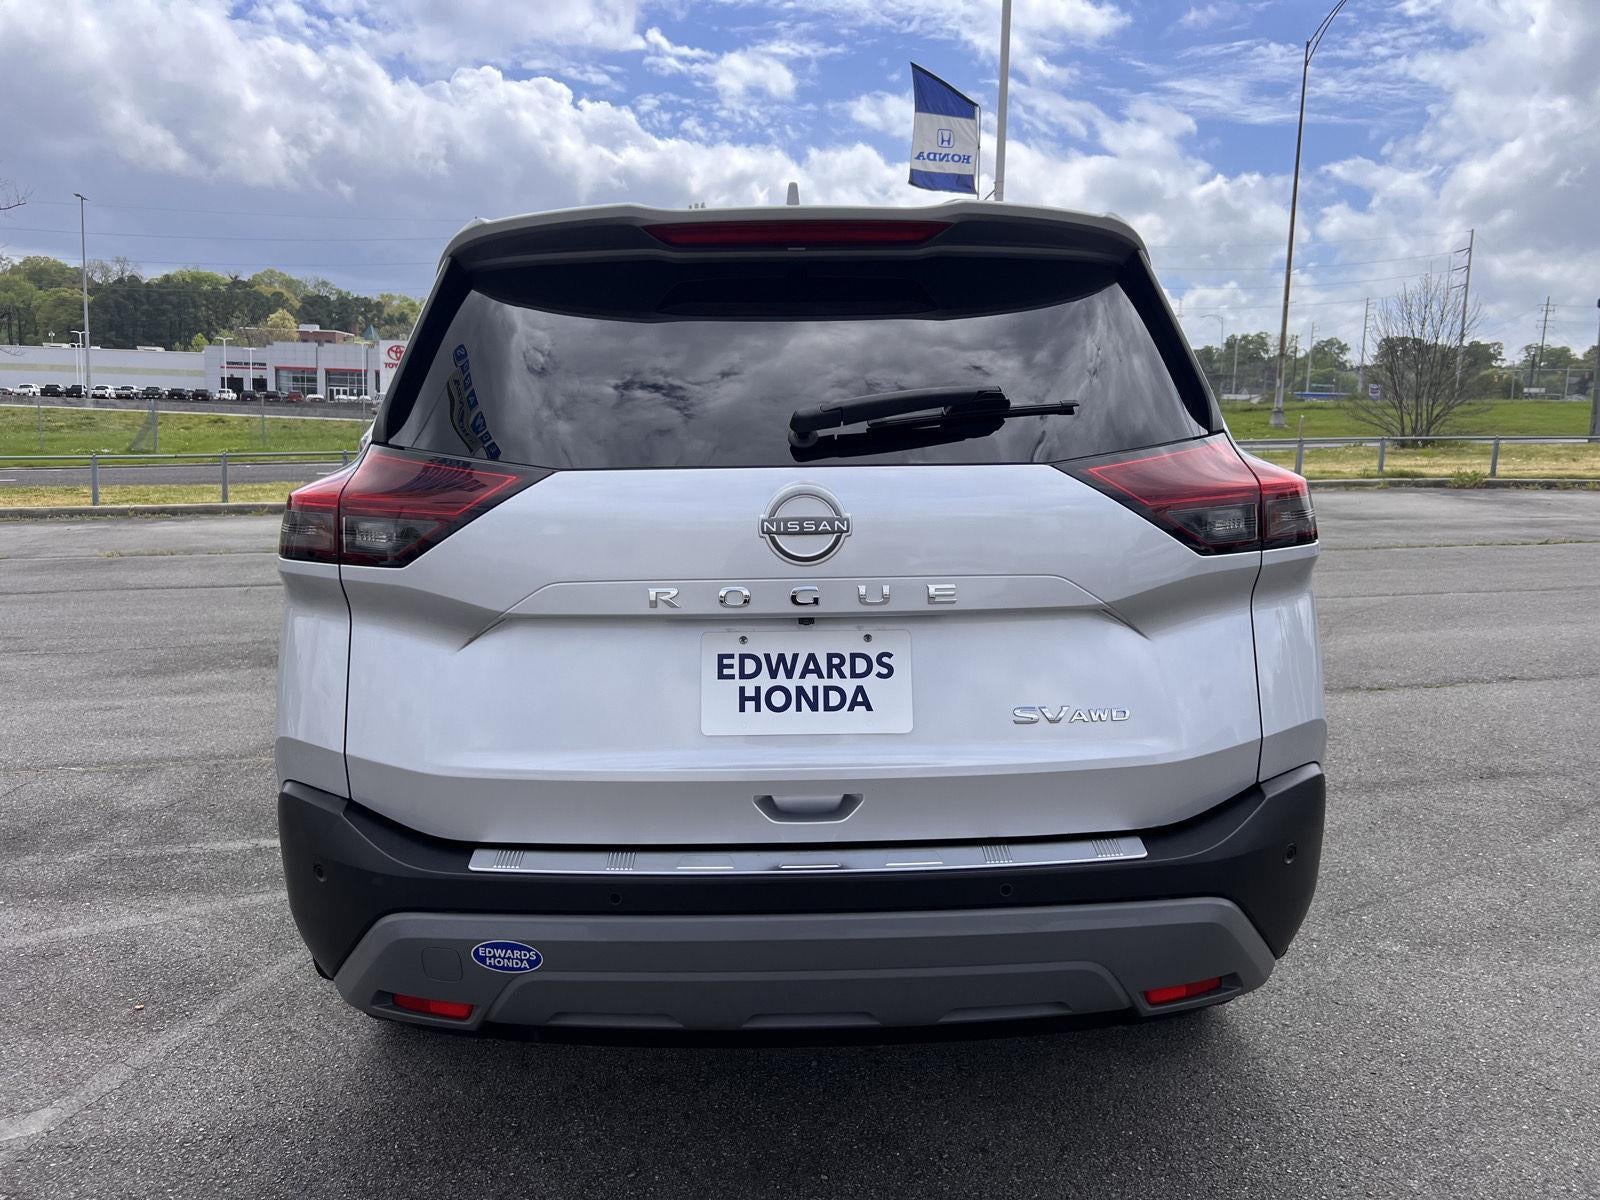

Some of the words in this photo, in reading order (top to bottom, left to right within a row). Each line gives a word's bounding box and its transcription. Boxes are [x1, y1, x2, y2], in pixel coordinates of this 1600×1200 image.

[763, 520, 847, 532] NISSAN
[647, 583, 959, 609] ROGUE
[716, 651, 895, 680] EDWARDS
[738, 684, 874, 713] HONDA
[478, 947, 537, 960] EDWARDS
[486, 957, 530, 969] HONDA
